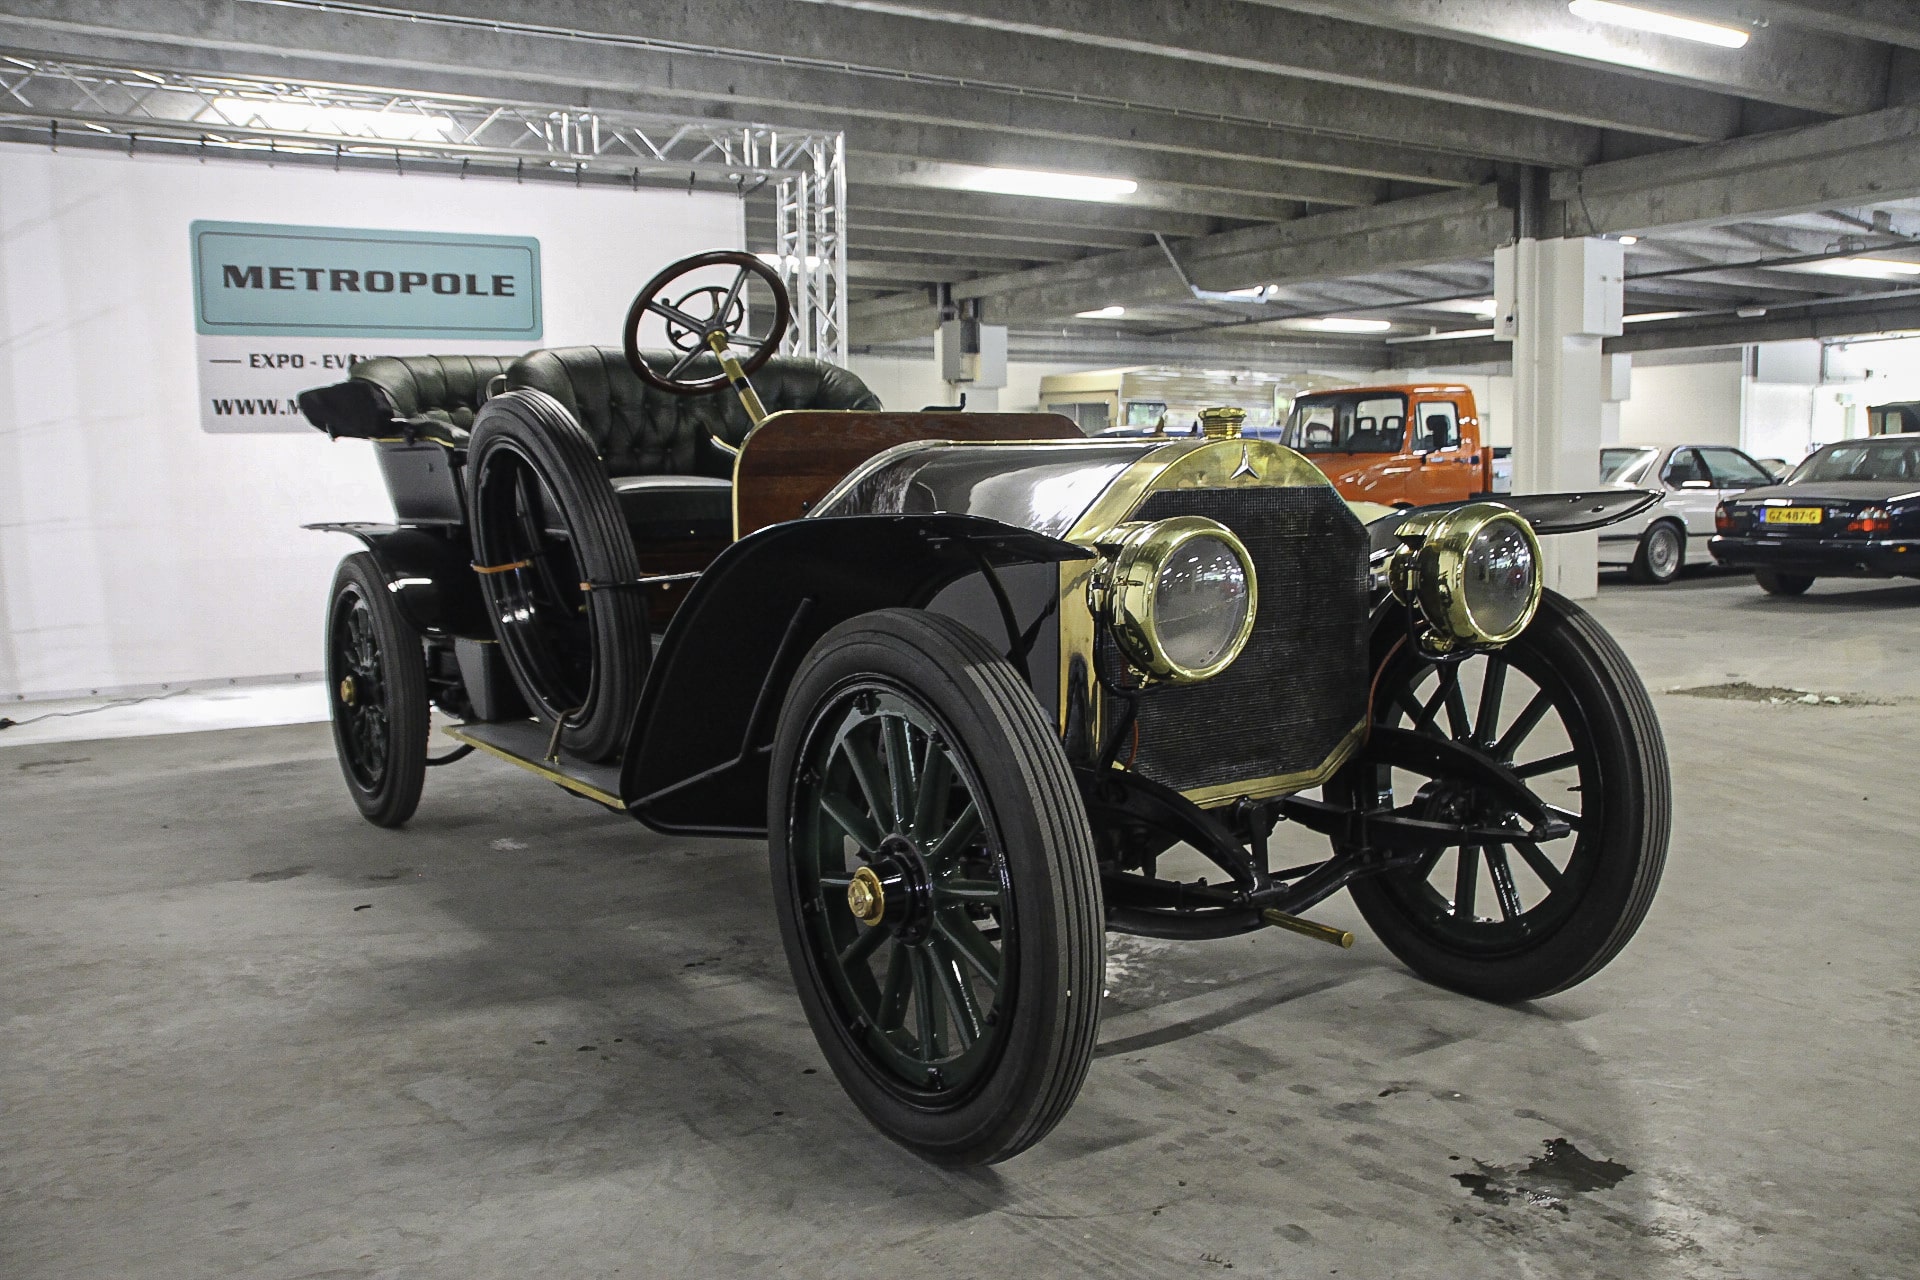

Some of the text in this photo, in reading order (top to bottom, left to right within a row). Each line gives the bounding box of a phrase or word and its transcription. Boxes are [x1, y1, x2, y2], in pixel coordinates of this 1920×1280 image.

[222, 264, 515, 297] METROPOLE
[249, 353, 304, 368] EXPO
[212, 398, 299, 415] WWW.M
